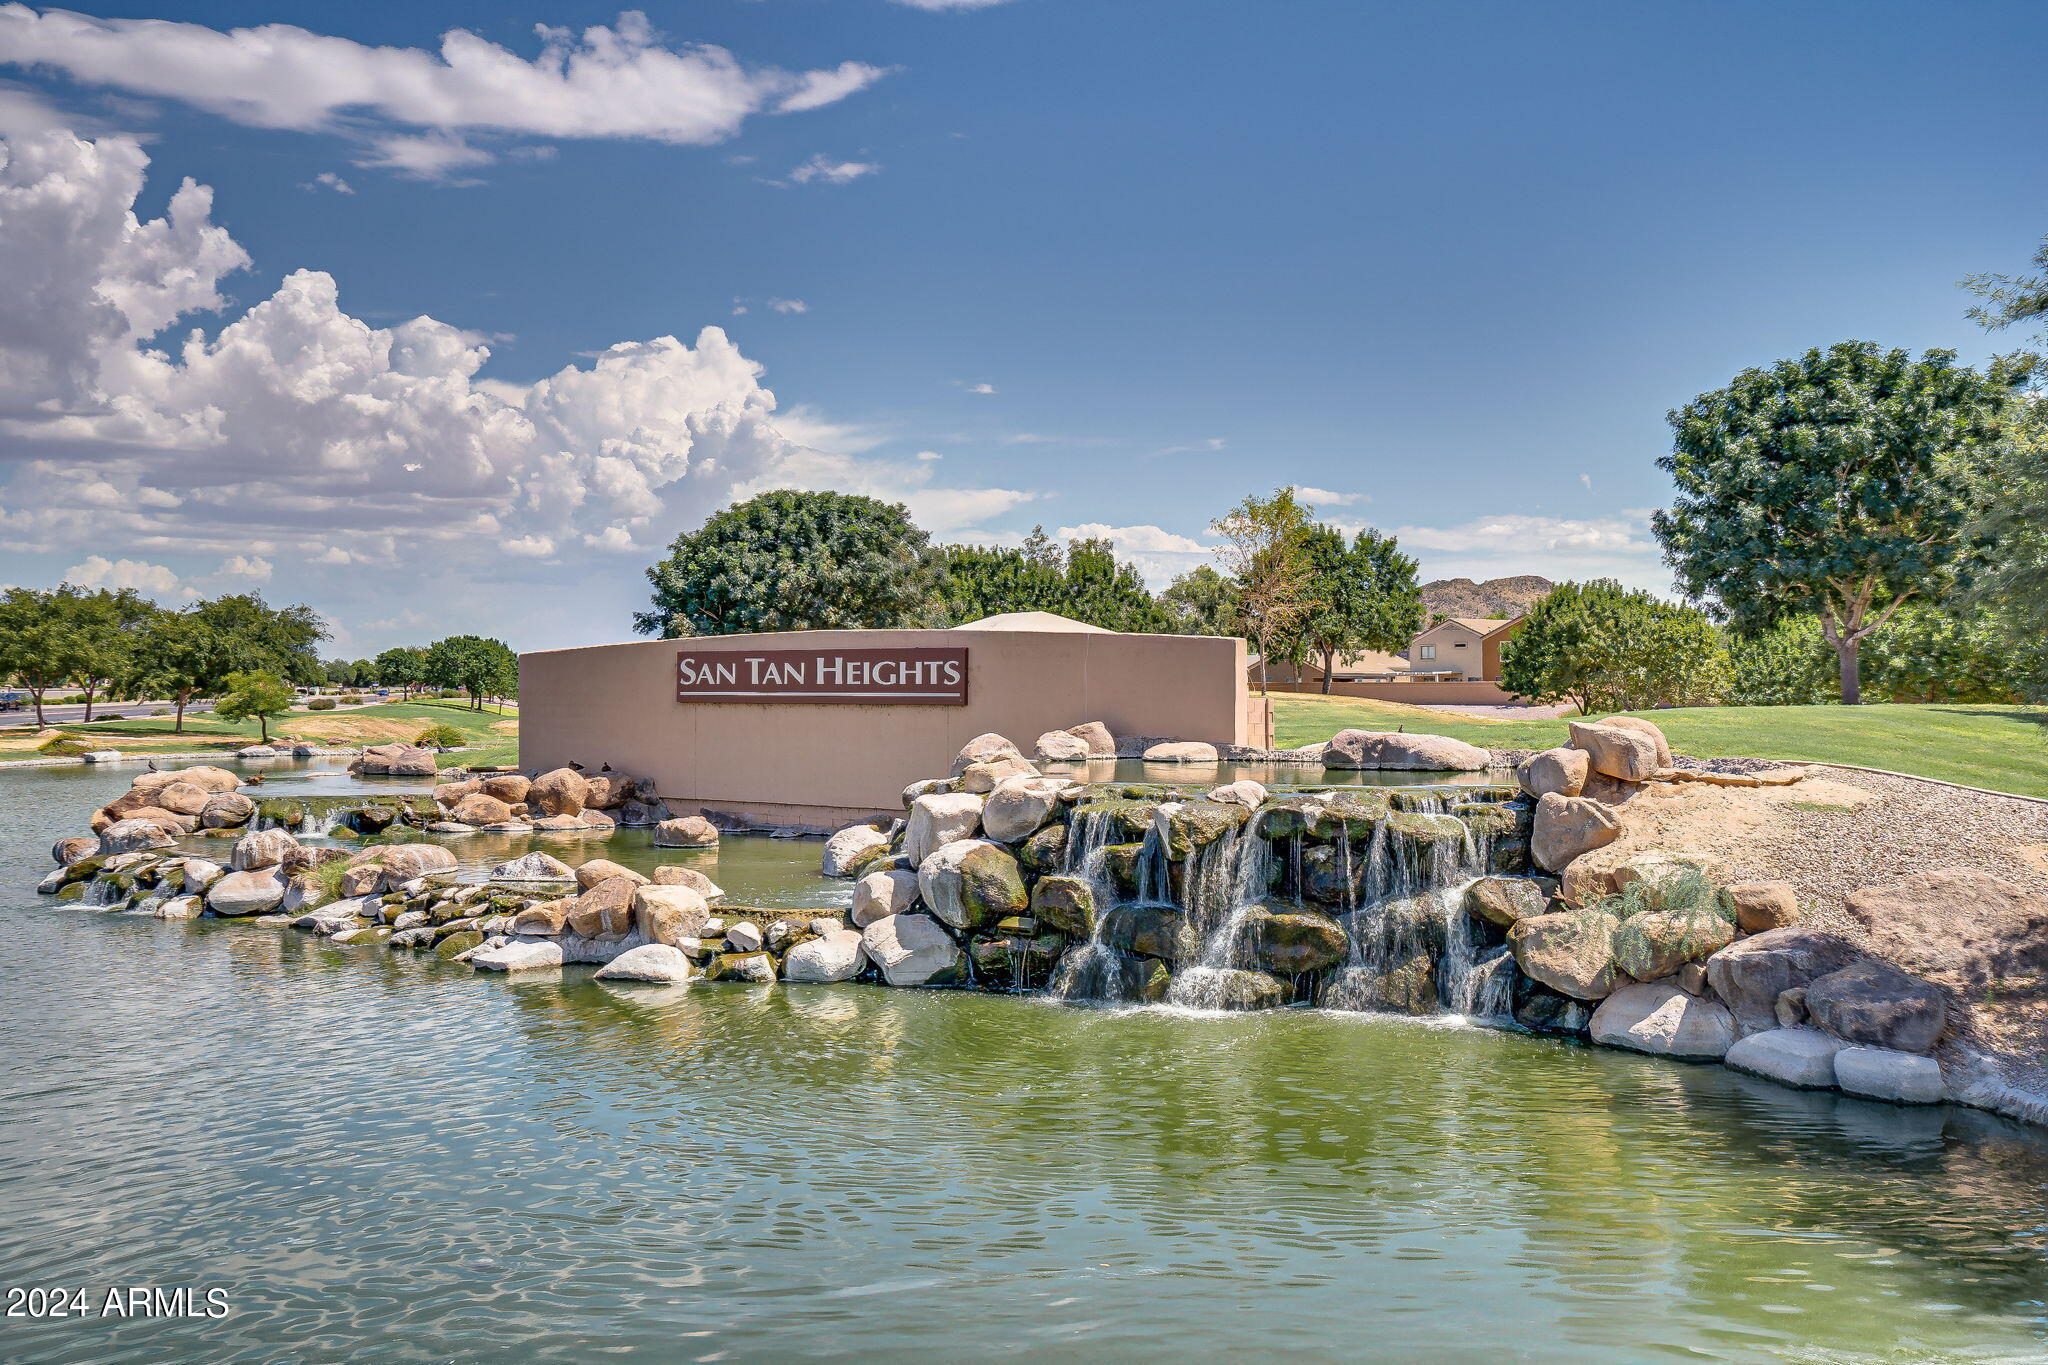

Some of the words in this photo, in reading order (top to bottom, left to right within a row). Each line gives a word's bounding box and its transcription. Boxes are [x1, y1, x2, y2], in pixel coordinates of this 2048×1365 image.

[679, 658, 736, 685] SAN
[744, 657, 805, 685] TAN
[816, 657, 961, 686] HEIGHTS
